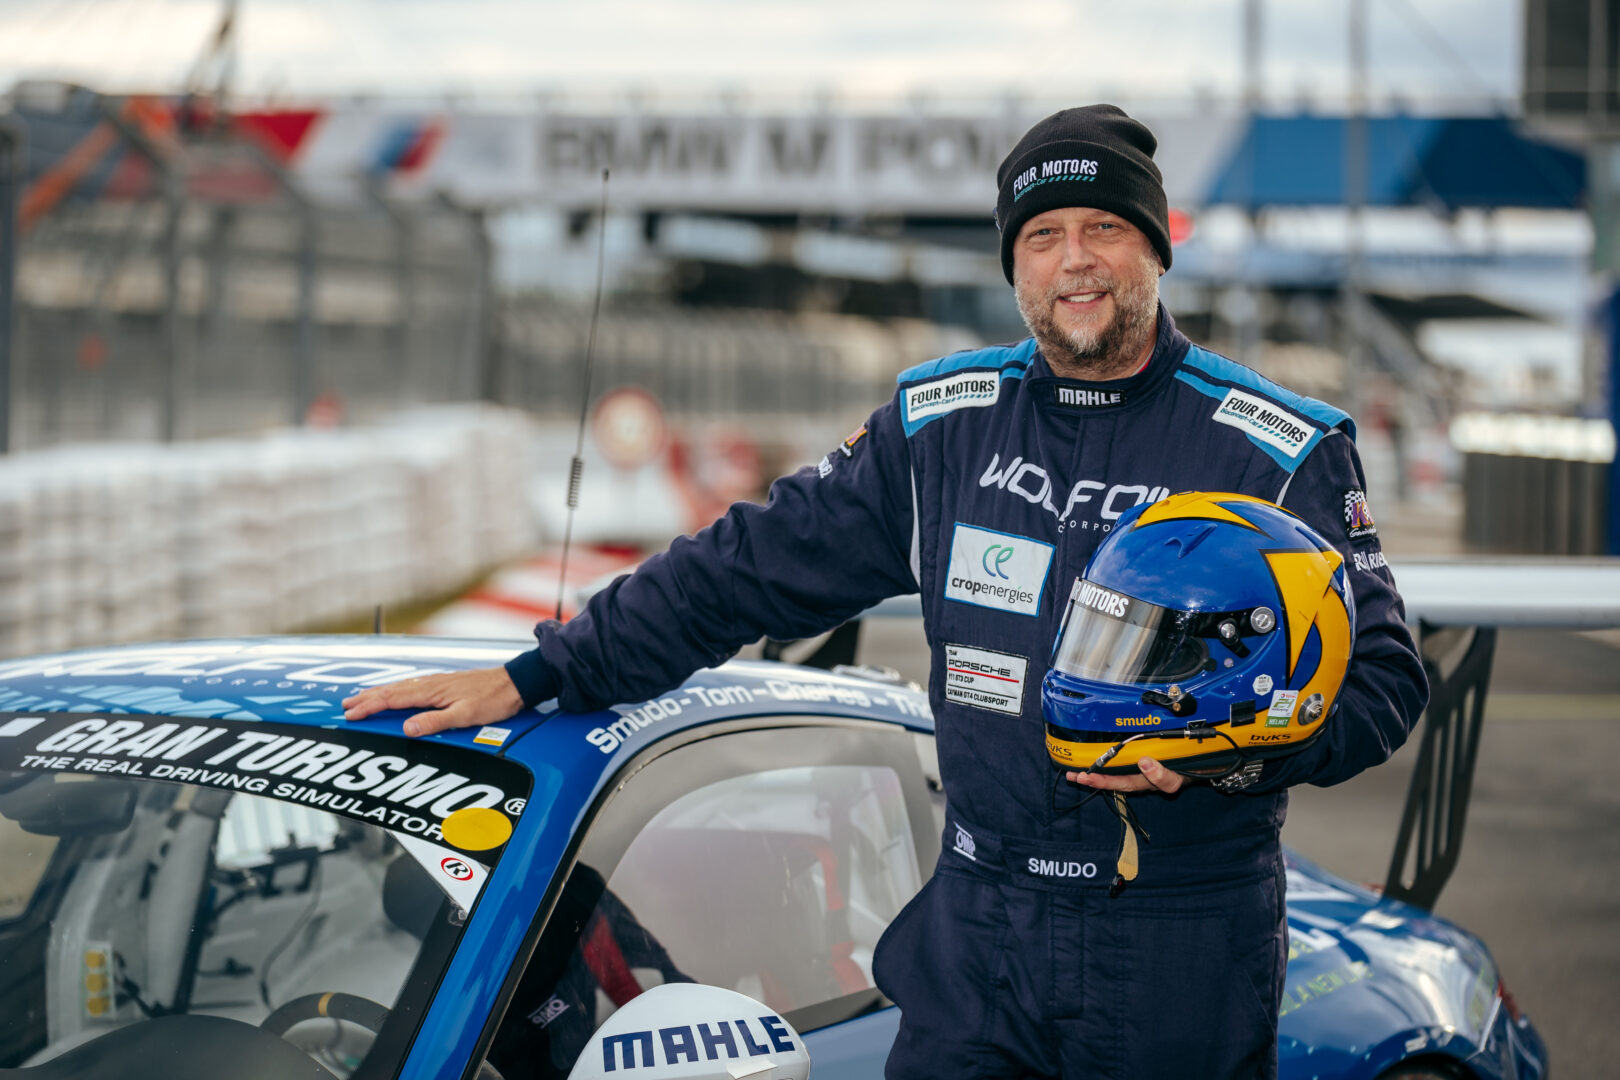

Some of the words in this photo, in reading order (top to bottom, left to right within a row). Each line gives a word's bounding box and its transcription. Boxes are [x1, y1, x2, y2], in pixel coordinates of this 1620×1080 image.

[1013, 166, 1037, 196] FOUR
[1042, 159, 1098, 178] MOTORS
[911, 387, 942, 406] FOUR
[945, 380, 995, 398] MOTORS
[1059, 388, 1121, 405] MAHLE
[1225, 397, 1259, 417] FOUR
[1256, 409, 1307, 443] MOTORS
[951, 577, 1034, 604] cropenergies
[1077, 583, 1129, 617] MOTORS
[948, 659, 1011, 677] PORSCHE
[964, 676, 974, 684] CUP
[973, 693, 1008, 707] CLUBSPORT
[1115, 714, 1161, 727] smudo
[1268, 718, 1288, 726] HELMET
[35, 718, 228, 761] GRAN
[204, 730, 505, 819] TURISMO
[19, 755, 75, 769] THE
[74, 758, 144, 775] REAL
[149, 764, 270, 793] DRIVING
[272, 782, 444, 841] SIMULATOR
[955, 830, 976, 856] OMP
[1028, 857, 1097, 878] SMUDO
[602, 1015, 796, 1073] MAHLE
